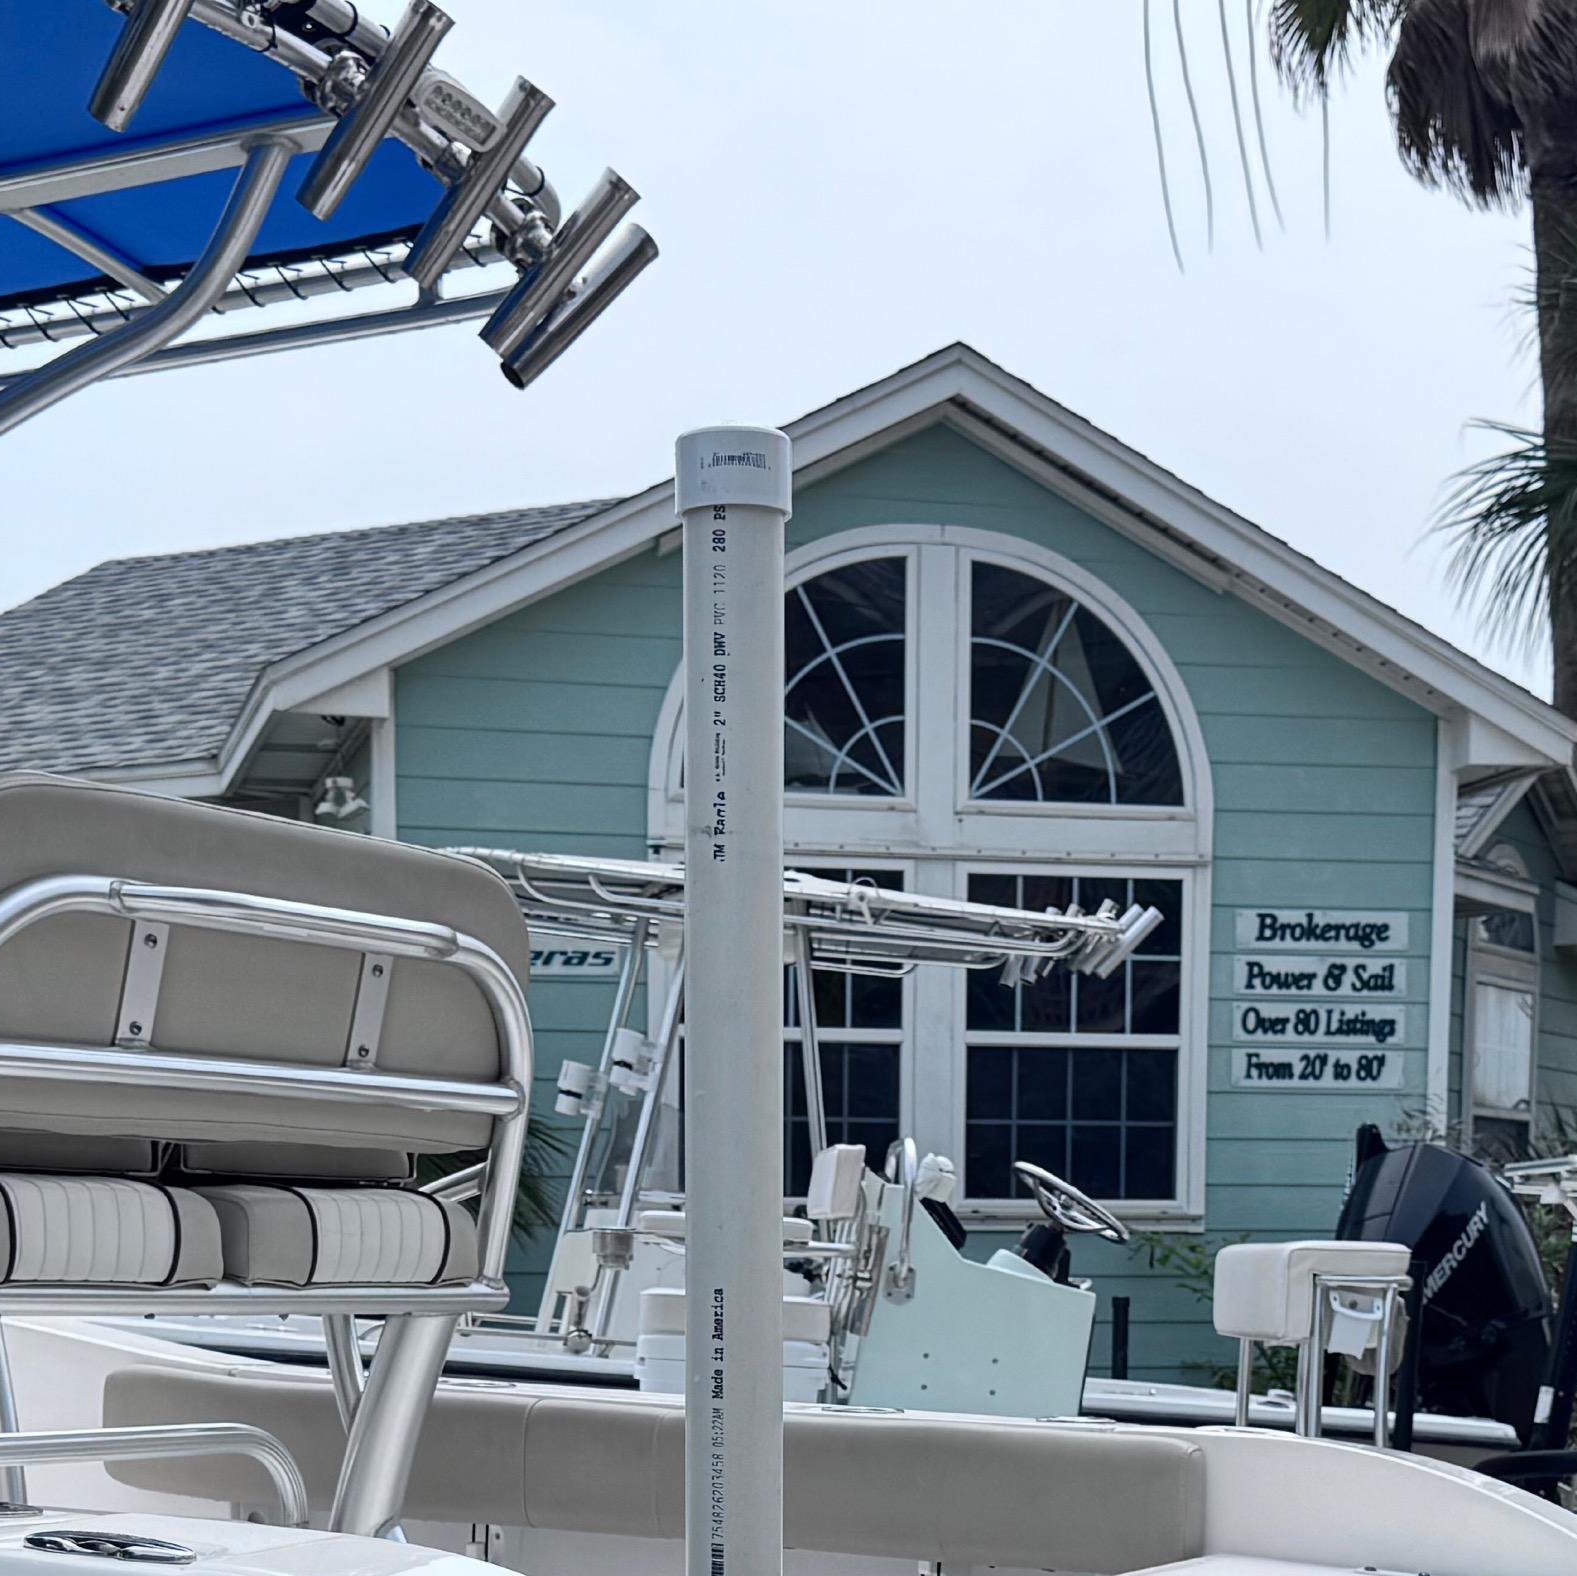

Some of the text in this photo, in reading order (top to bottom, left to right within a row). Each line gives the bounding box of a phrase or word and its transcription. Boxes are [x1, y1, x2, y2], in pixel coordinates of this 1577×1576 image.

[714, 504, 726, 521] PS
[714, 529, 726, 552] 280
[714, 664, 726, 703] SCH40
[1255, 912, 1390, 949] Brokerage
[1245, 961, 1395, 992] Power & Sail
[1242, 1007, 1396, 1043] Over 80 Listings
[1244, 1053, 1385, 1080] From 20' to 80'
[1423, 1201, 1490, 1304] MERCURY
[712, 1288, 724, 1341] America
[712, 1347, 724, 1362] in
[712, 1369, 724, 1400] Made
